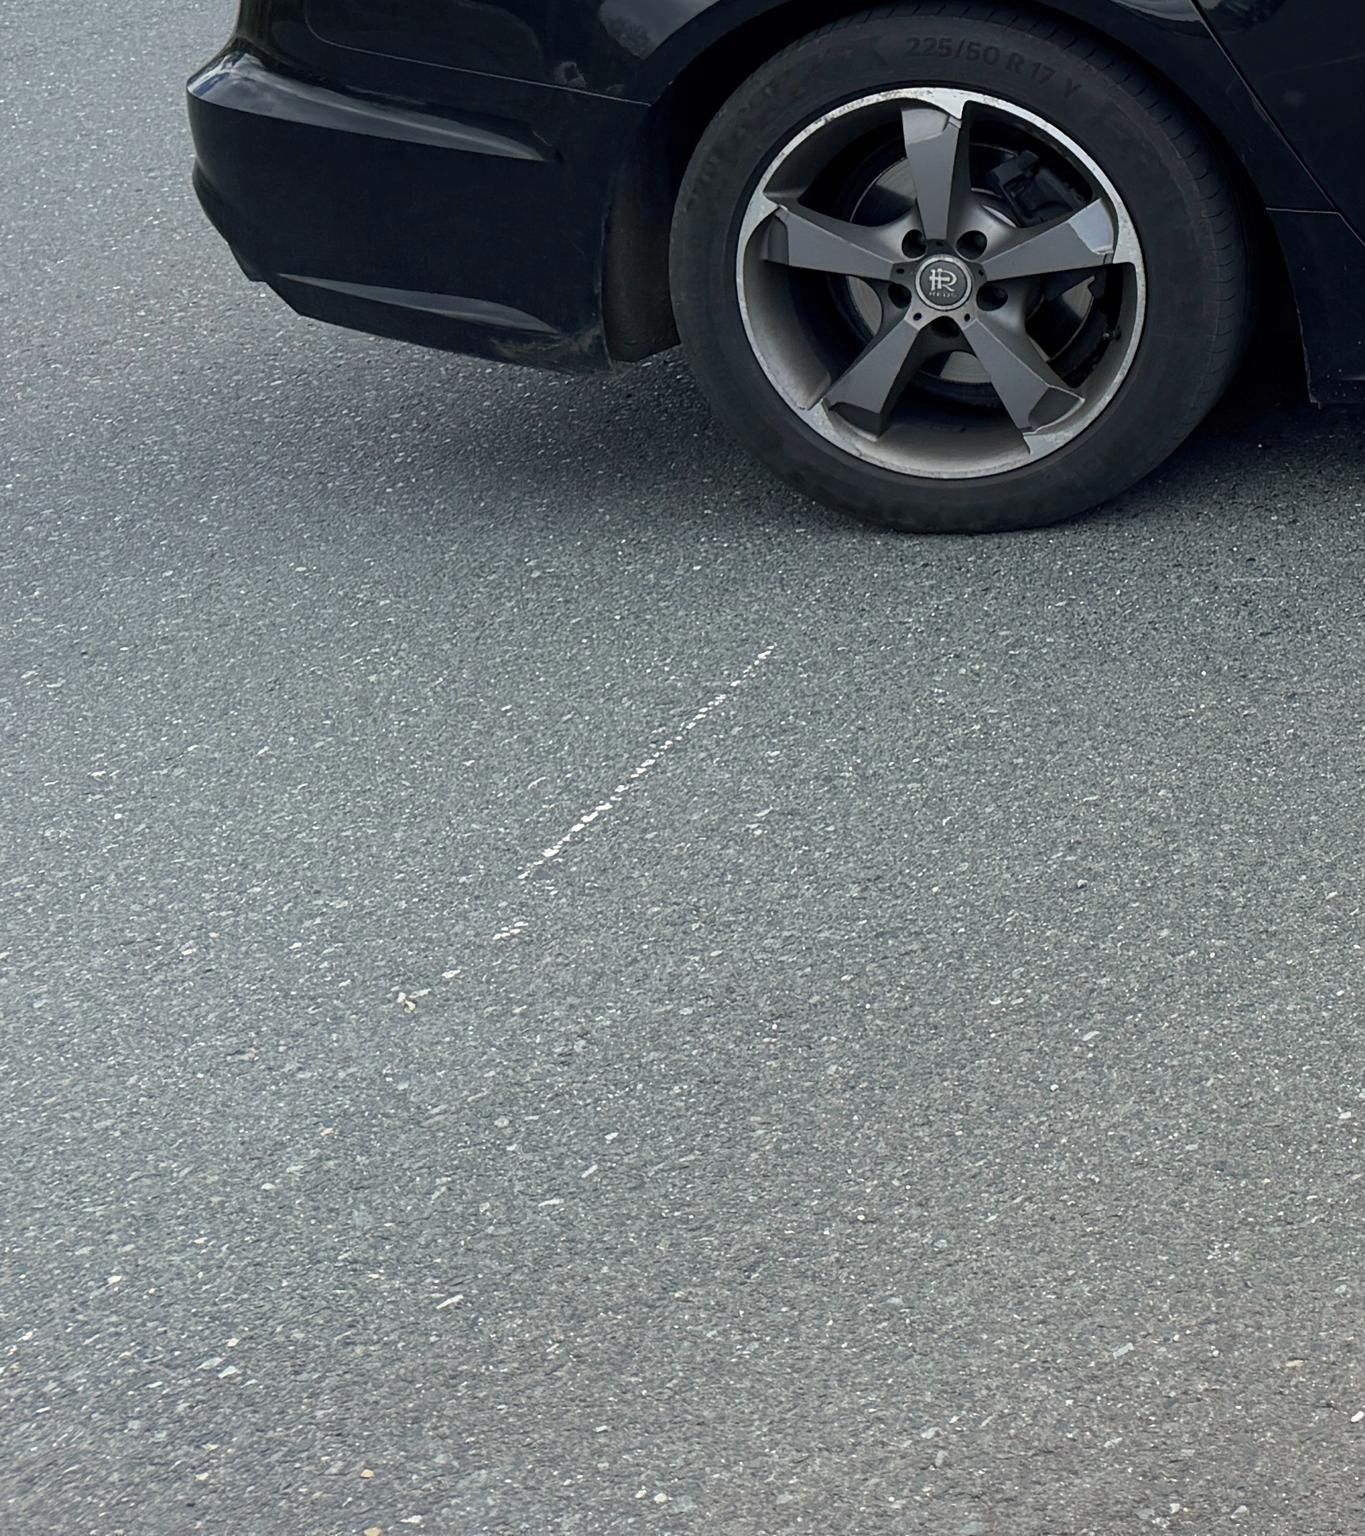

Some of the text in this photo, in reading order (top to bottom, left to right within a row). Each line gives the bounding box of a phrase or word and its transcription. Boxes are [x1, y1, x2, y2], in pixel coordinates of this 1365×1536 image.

[905, 37, 1000, 65] 225/50
[1006, 52, 1025, 74] R
[1031, 62, 1056, 85] 17
